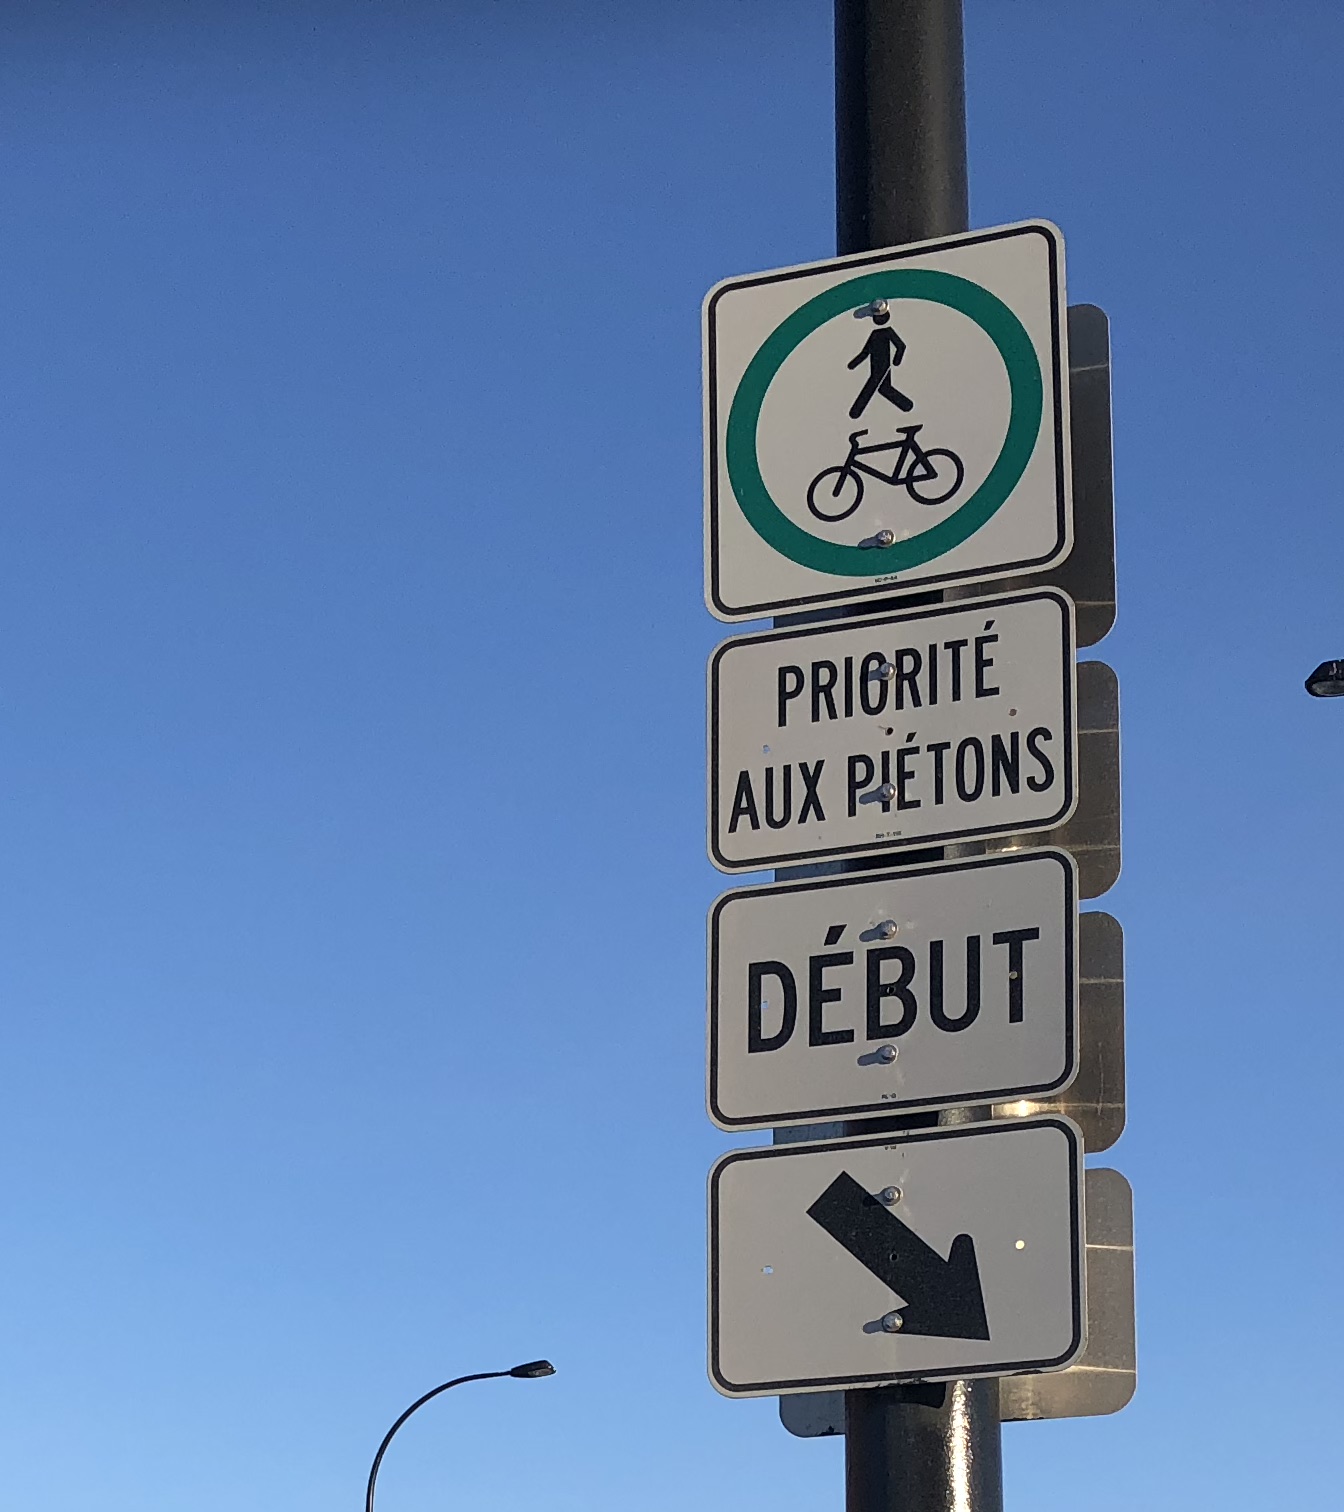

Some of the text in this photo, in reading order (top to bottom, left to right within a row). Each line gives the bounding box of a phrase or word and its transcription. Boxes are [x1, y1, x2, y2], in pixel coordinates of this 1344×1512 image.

[776, 620, 1000, 728] PRIORITÉ
[728, 726, 1055, 835] AUX PIÉTONS
[747, 923, 1040, 1054] DÉBUT
